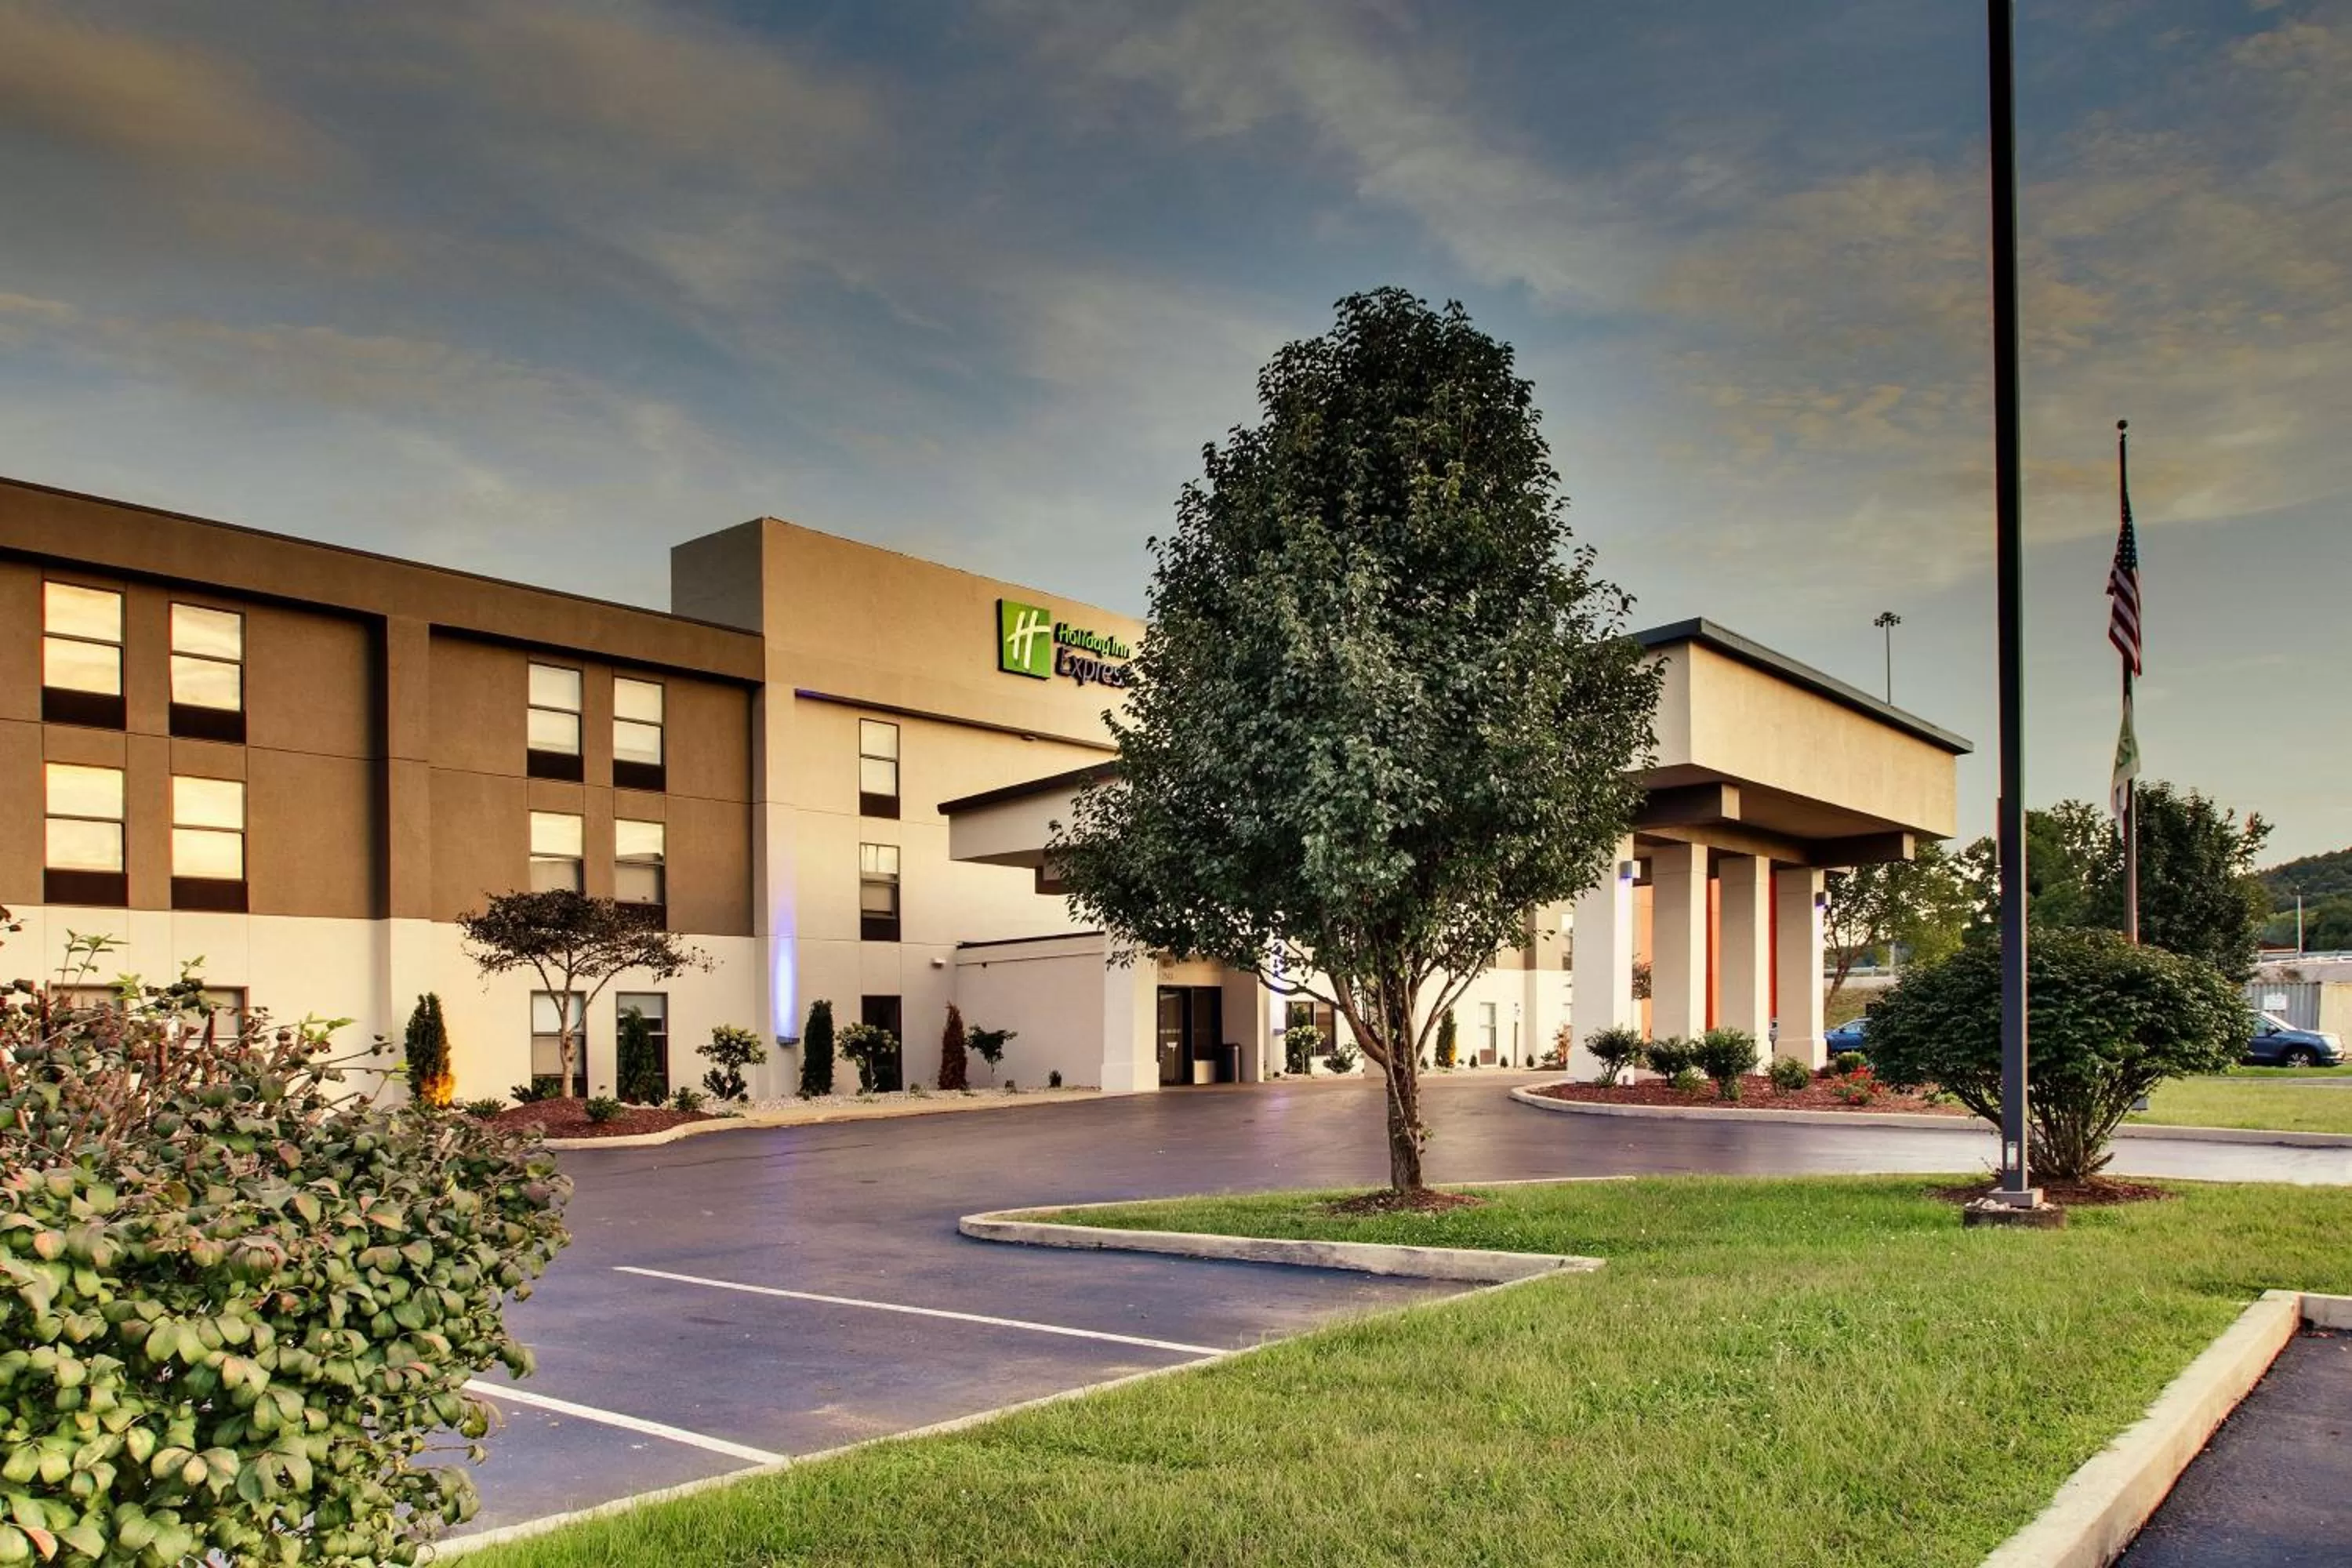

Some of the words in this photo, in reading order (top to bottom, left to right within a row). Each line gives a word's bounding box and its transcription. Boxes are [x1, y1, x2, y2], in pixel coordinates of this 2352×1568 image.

[1007, 610, 1051, 670] H
[1056, 622, 1111, 657] Holiday
[1110, 636, 1131, 657] Inn
[1057, 646, 1131, 687] Expres
